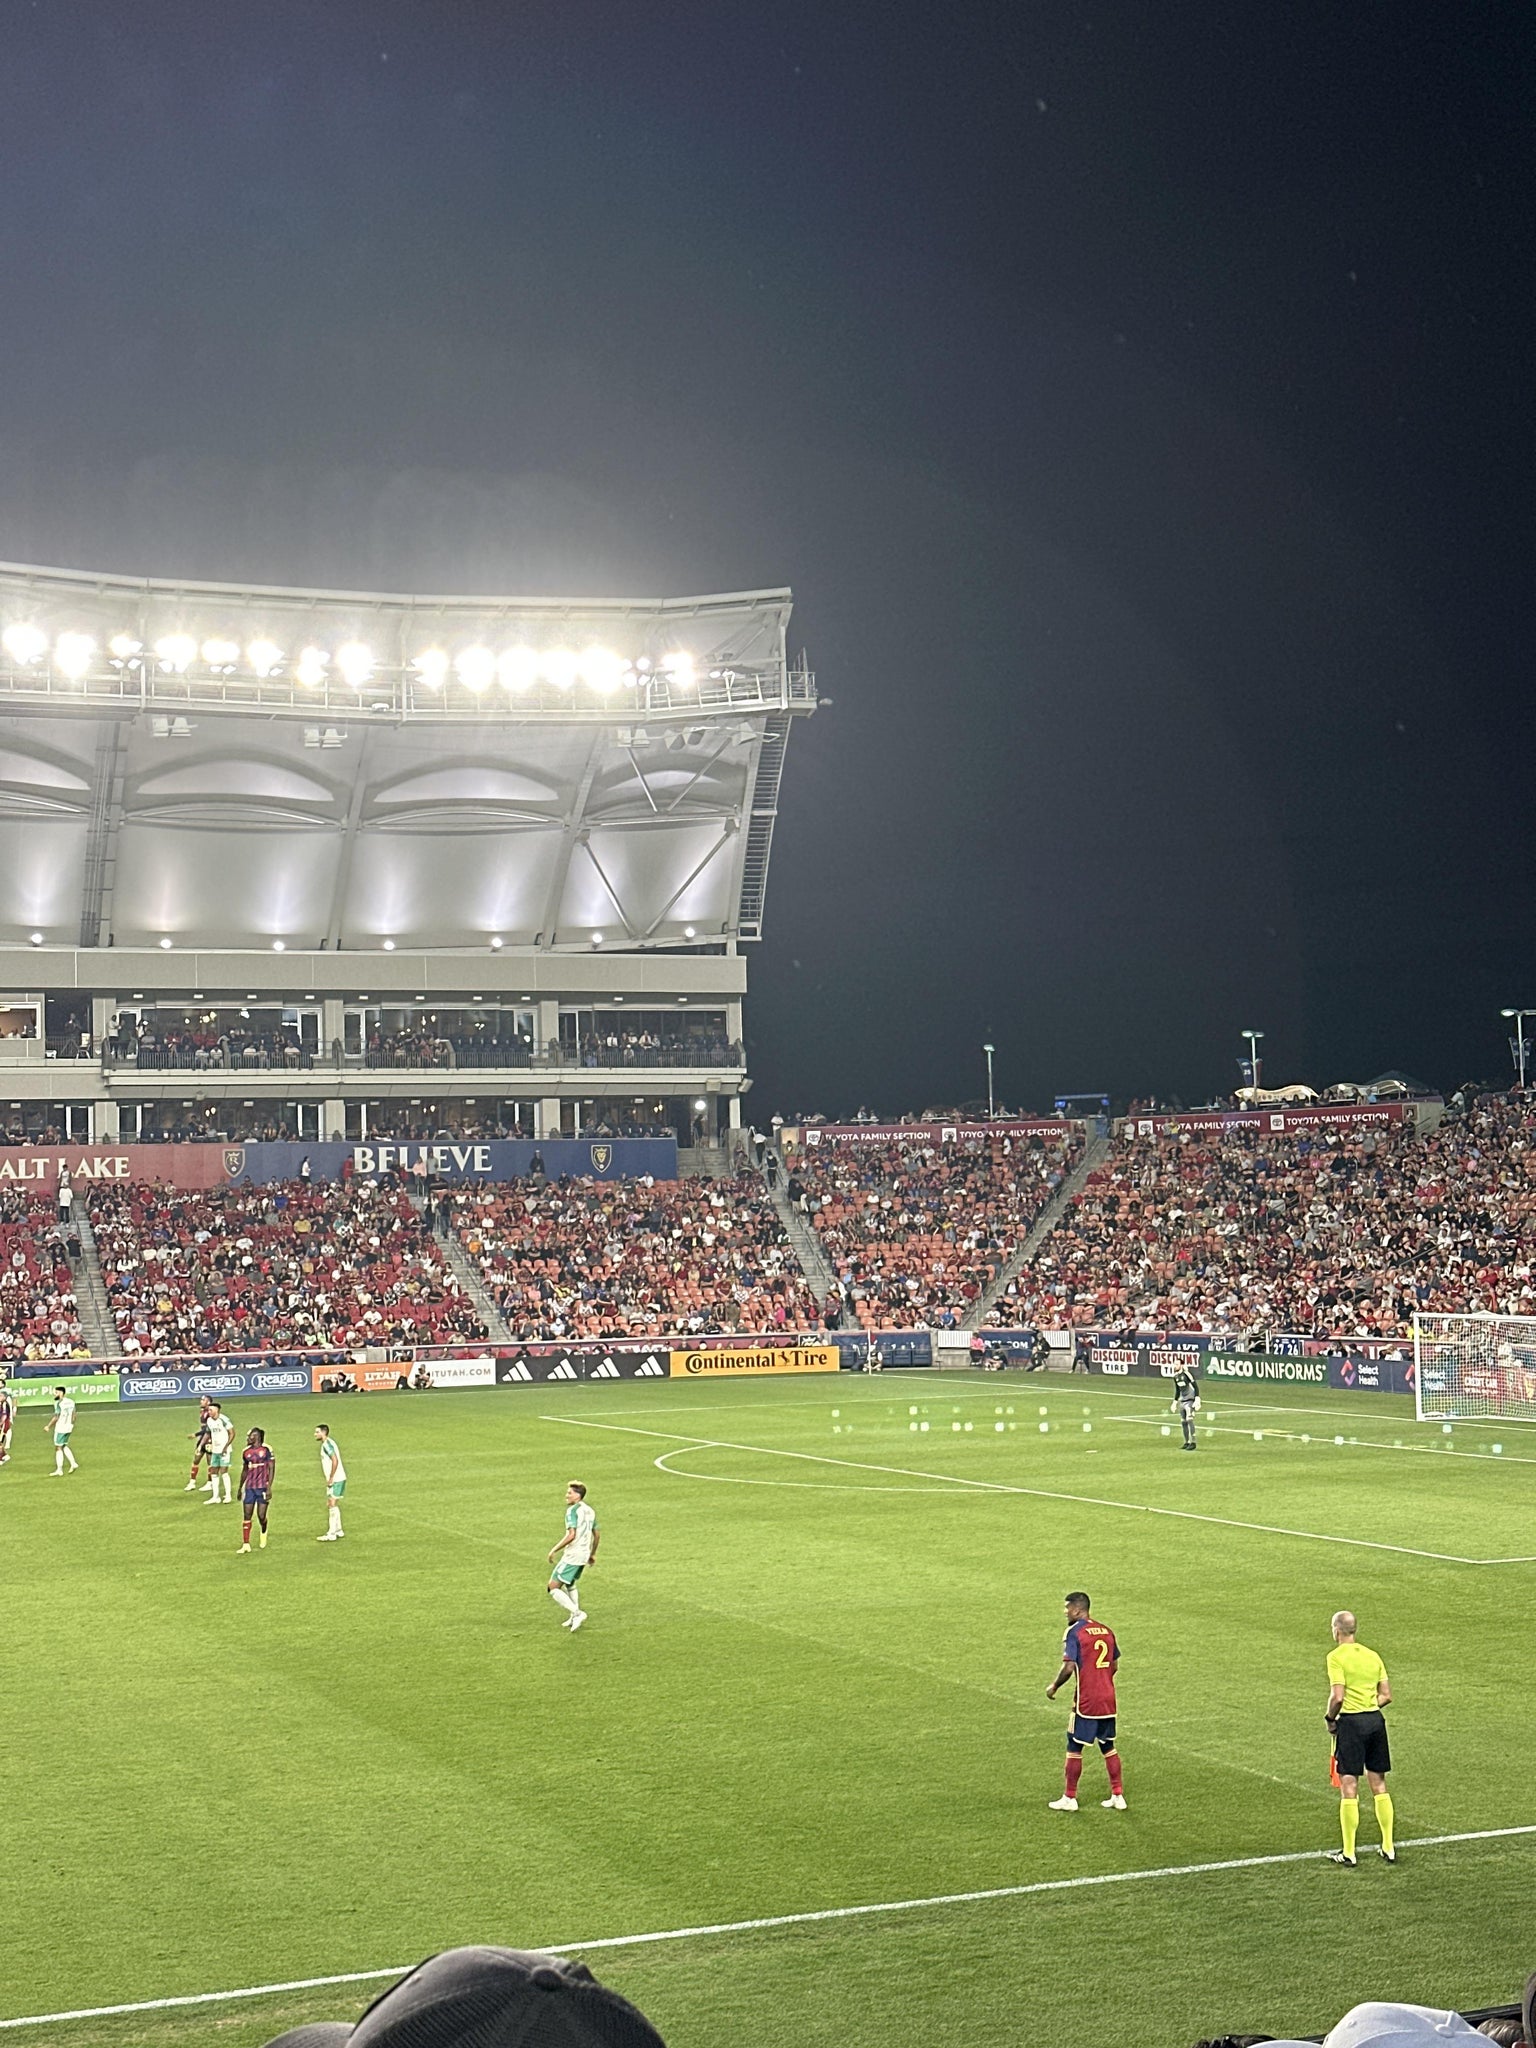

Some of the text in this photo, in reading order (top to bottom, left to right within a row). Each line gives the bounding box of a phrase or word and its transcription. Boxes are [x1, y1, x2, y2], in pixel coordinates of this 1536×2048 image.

[1193, 1121, 1225, 1130] FAMILY
[1226, 1119, 1261, 1129] SECTION
[1286, 1112, 1389, 1126] TOYOTA FAMILY SECTION
[860, 1132, 891, 1141] FAMILY
[893, 1131, 931, 1140] SECTION
[959, 1130, 995, 1139] TOYOA
[1026, 1127, 1064, 1137] SECTION
[57, 1156, 131, 1180] LAKE
[1092, 1350, 1138, 1363] DISCOUNT
[1273, 1343, 1298, 1356] 27 26
[685, 1350, 828, 1374] Continental Tire
[1104, 1363, 1125, 1373] TIRE
[1207, 1357, 1253, 1377] ALSCO
[1357, 1363, 1379, 1376] Select
[129, 1378, 176, 1394] Reagan
[193, 1375, 241, 1391] Reagan
[257, 1372, 303, 1388] Reagan
[1358, 1375, 1379, 1386] Health
[81, 1382, 116, 1397] Upper
[1093, 1639, 1111, 1669] 2
